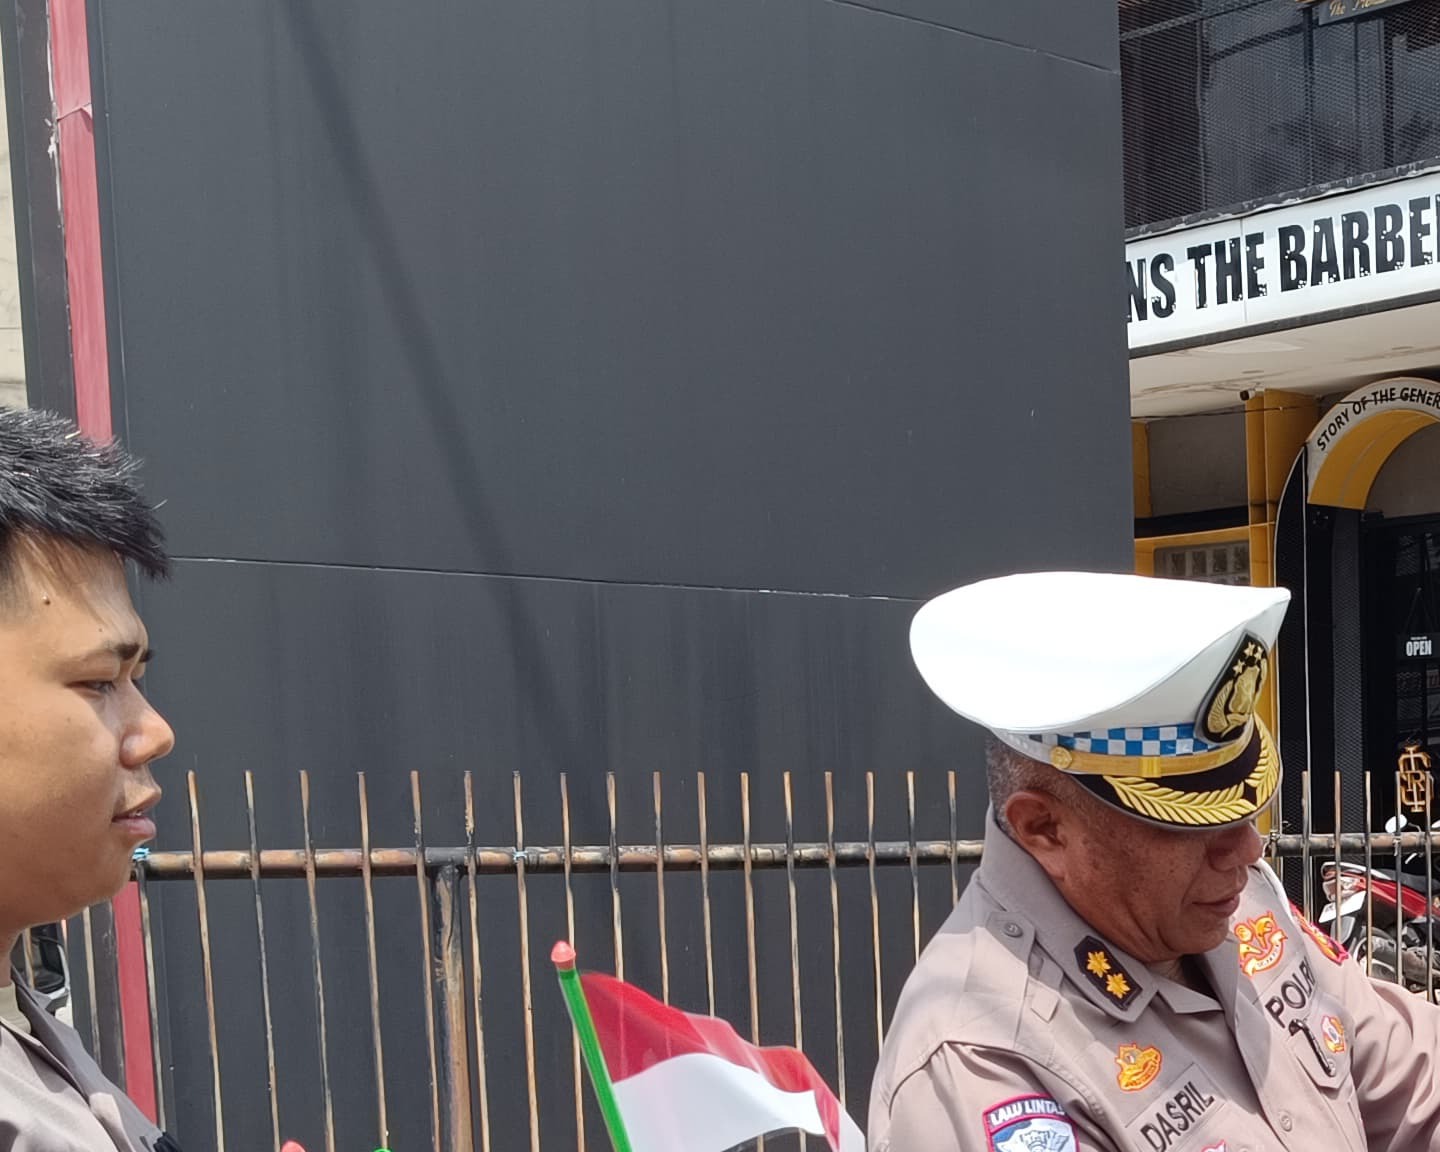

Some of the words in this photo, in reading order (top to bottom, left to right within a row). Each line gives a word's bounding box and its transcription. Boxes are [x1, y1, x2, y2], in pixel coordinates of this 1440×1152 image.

[1187, 231, 1268, 309] THE
[1317, 408, 1351, 451] STORY
[1352, 396, 1368, 415] OF
[1371, 387, 1396, 406] THE
[1405, 639, 1432, 657] OPEN
[990, 1100, 1023, 1126] LALU
